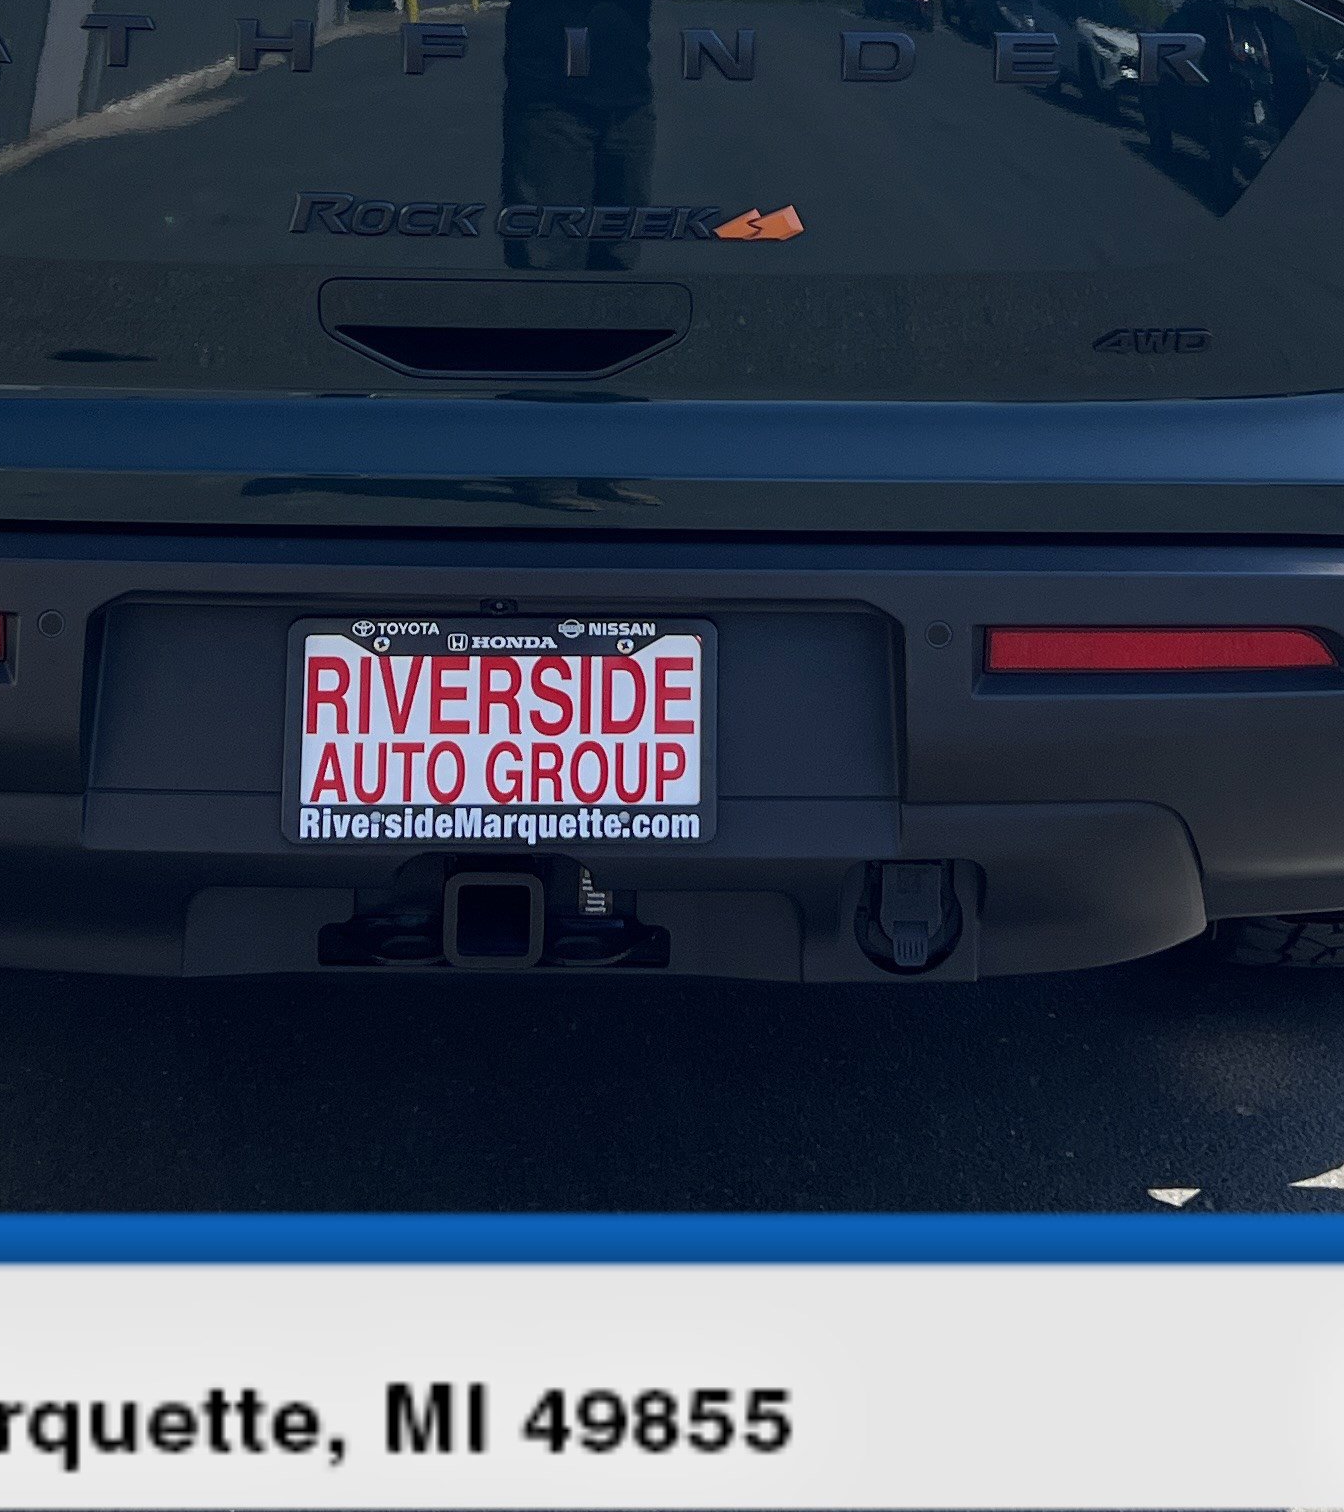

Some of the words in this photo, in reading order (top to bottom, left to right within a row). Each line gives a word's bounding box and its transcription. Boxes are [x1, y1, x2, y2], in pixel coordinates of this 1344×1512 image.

[289, 191, 487, 237] ROCK
[497, 204, 721, 239] CREEK
[1091, 327, 1213, 355] 4WD
[376, 622, 440, 637] TOYOTA
[470, 635, 558, 650] HONDA
[587, 621, 657, 637] NISSAN
[304, 654, 696, 737] RIVERSIDE
[308, 740, 466, 805] AUTO
[484, 739, 687, 805] GROUP
[298, 807, 701, 846] RiversideMarquette.com
